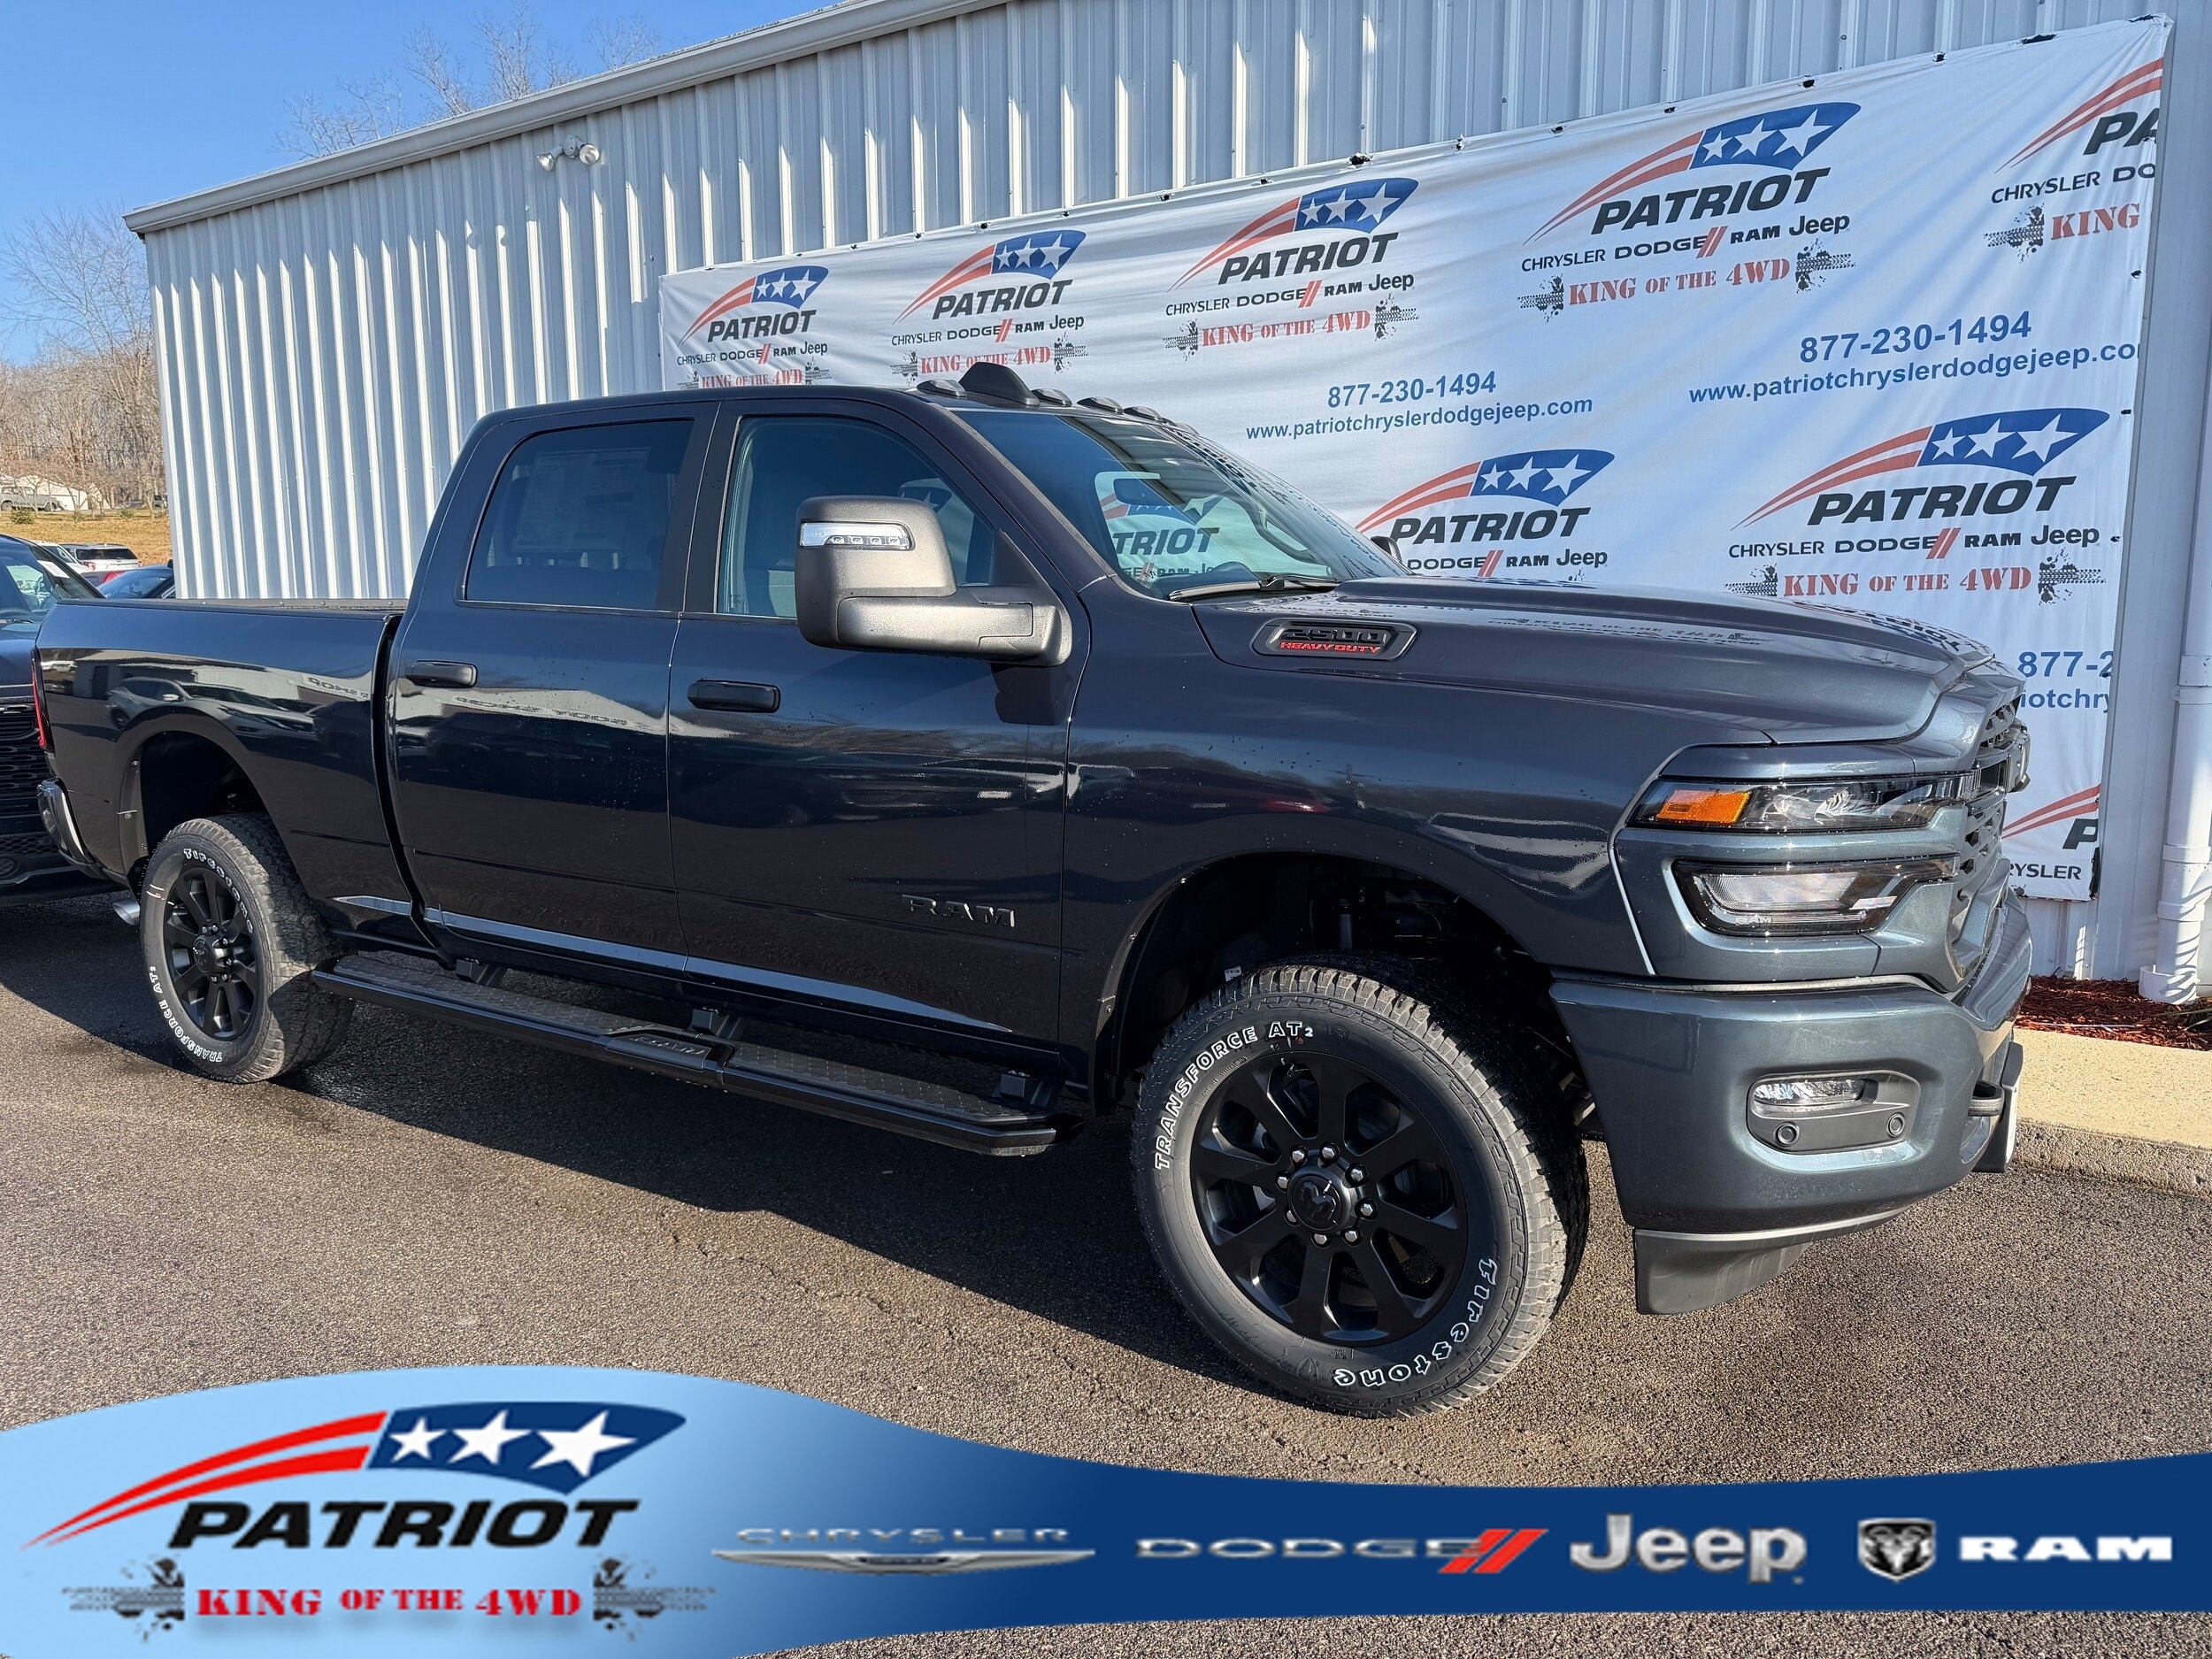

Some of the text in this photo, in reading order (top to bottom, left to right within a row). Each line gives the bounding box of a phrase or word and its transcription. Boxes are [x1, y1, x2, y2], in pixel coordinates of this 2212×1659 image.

[1591, 166, 1831, 235] PATRIOT
[1991, 171, 2101, 204] CHRYSLER
[2050, 203, 2140, 240] KING
[1217, 232, 1399, 286] PATRIOT
[1521, 215, 1850, 273] CHRYSLER DODGE RAM Jeep
[932, 279, 1073, 320] PATRIOT
[1165, 273, 1416, 317] CHRYSLER DODGE RAM Jeep
[1569, 257, 1791, 306] KING OF THE 4WD
[707, 309, 817, 343] PATRIOT
[892, 314, 1085, 346] CHRYSLER DODGE RAM Jeep
[1202, 310, 1371, 347] KING OF THE 4WD
[1800, 310, 2032, 365] 877-230-1494
[677, 342, 828, 365] CHRYSLER DODGE RAM Jeep
[920, 354, 962, 374] KING
[1013, 346, 1051, 365] 4WD
[702, 369, 803, 388] KING OF THE 4WD
[1327, 370, 1497, 409] 877-230-1494
[1246, 397, 1594, 441] www.patriotchryslerdodgejeep.com
[1807, 475, 2077, 526] PATRIOT
[1112, 526, 1220, 556] TRIOT
[1390, 507, 1592, 545] PATRIOT
[1728, 525, 2100, 559] CHRYSLER DODGE RAM Jeep
[1407, 549, 1609, 571] DODGE RAM Jeep
[1784, 566, 2032, 597] KING OF THE 4WD
[2009, 863, 2082, 880] YSLER
[901, 894, 1016, 928] RAM
[158, 999, 223, 1063] TRANSFORCE
[1154, 1025, 1256, 1171] TRANSFORCE
[1332, 1257, 1499, 1388] Firestone
